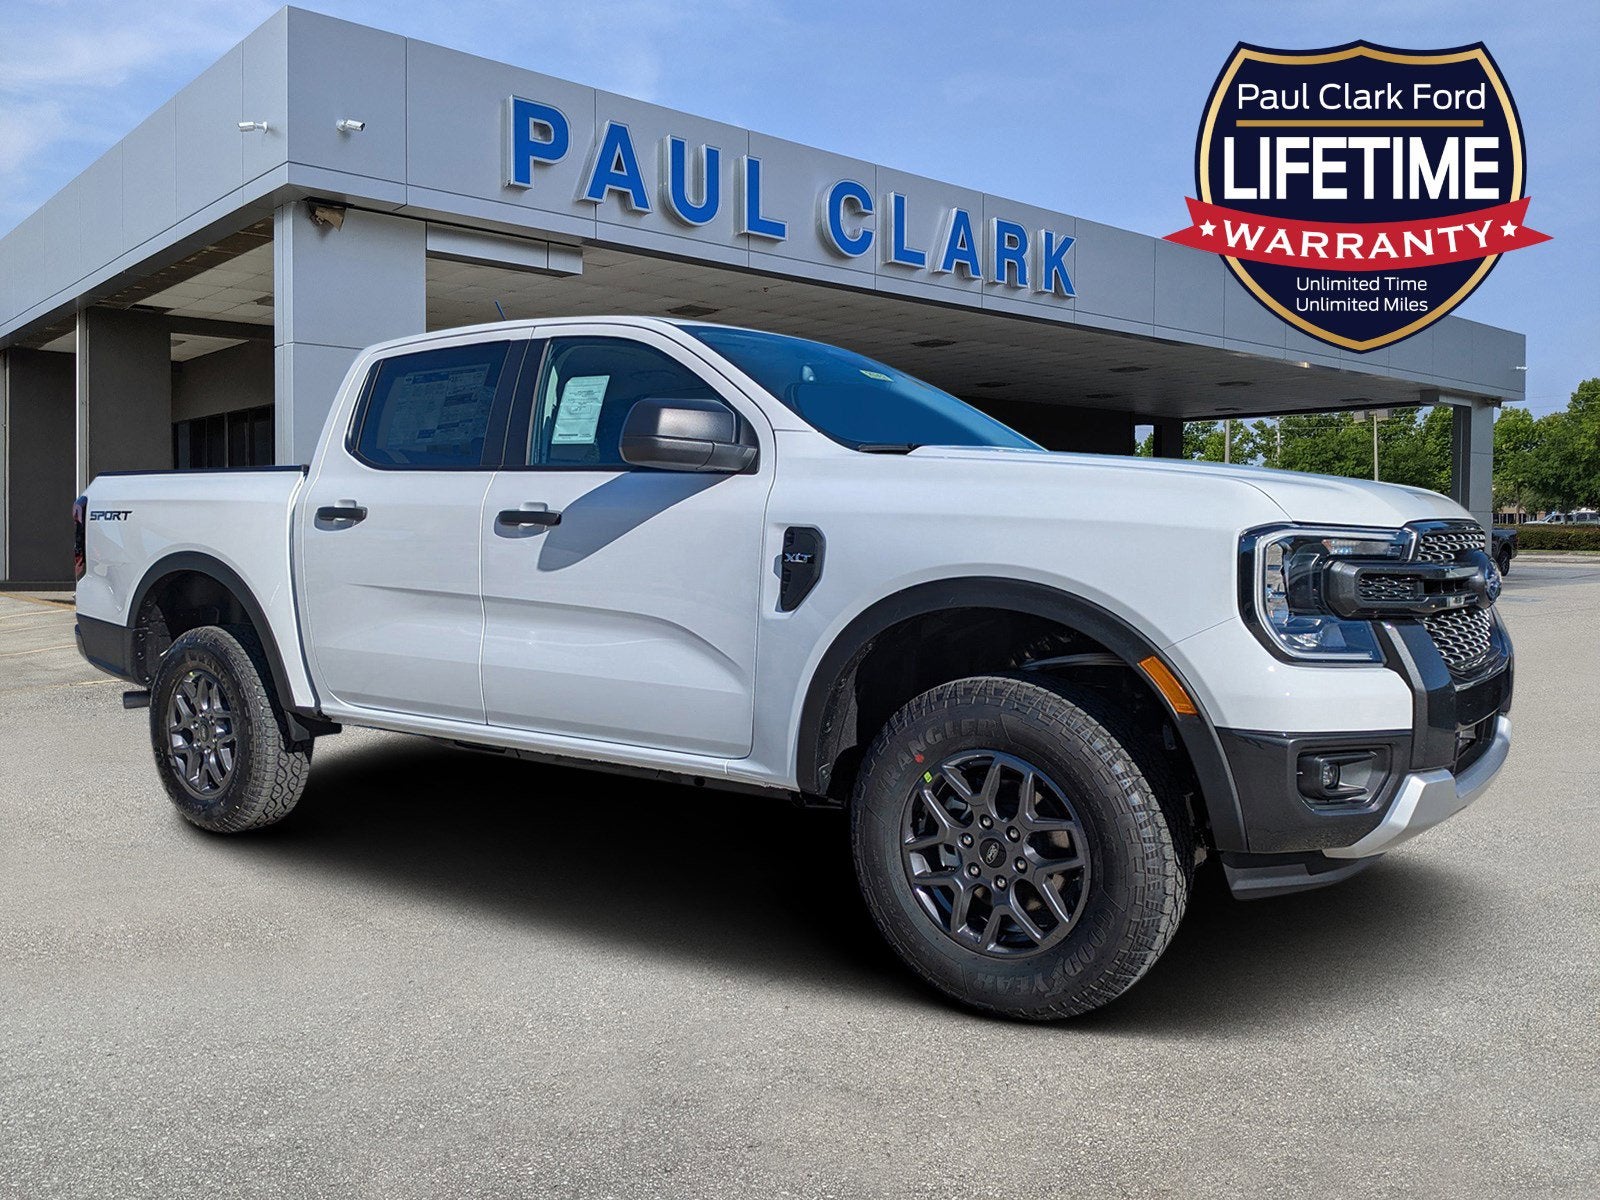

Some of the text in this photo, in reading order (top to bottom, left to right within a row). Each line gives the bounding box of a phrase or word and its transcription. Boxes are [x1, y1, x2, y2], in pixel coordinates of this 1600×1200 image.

[506, 95, 1077, 298] PAUL CLARK
[89, 510, 133, 521] SPORT
[784, 552, 813, 563] XLT
[973, 908, 1116, 999] GOODYEAR
